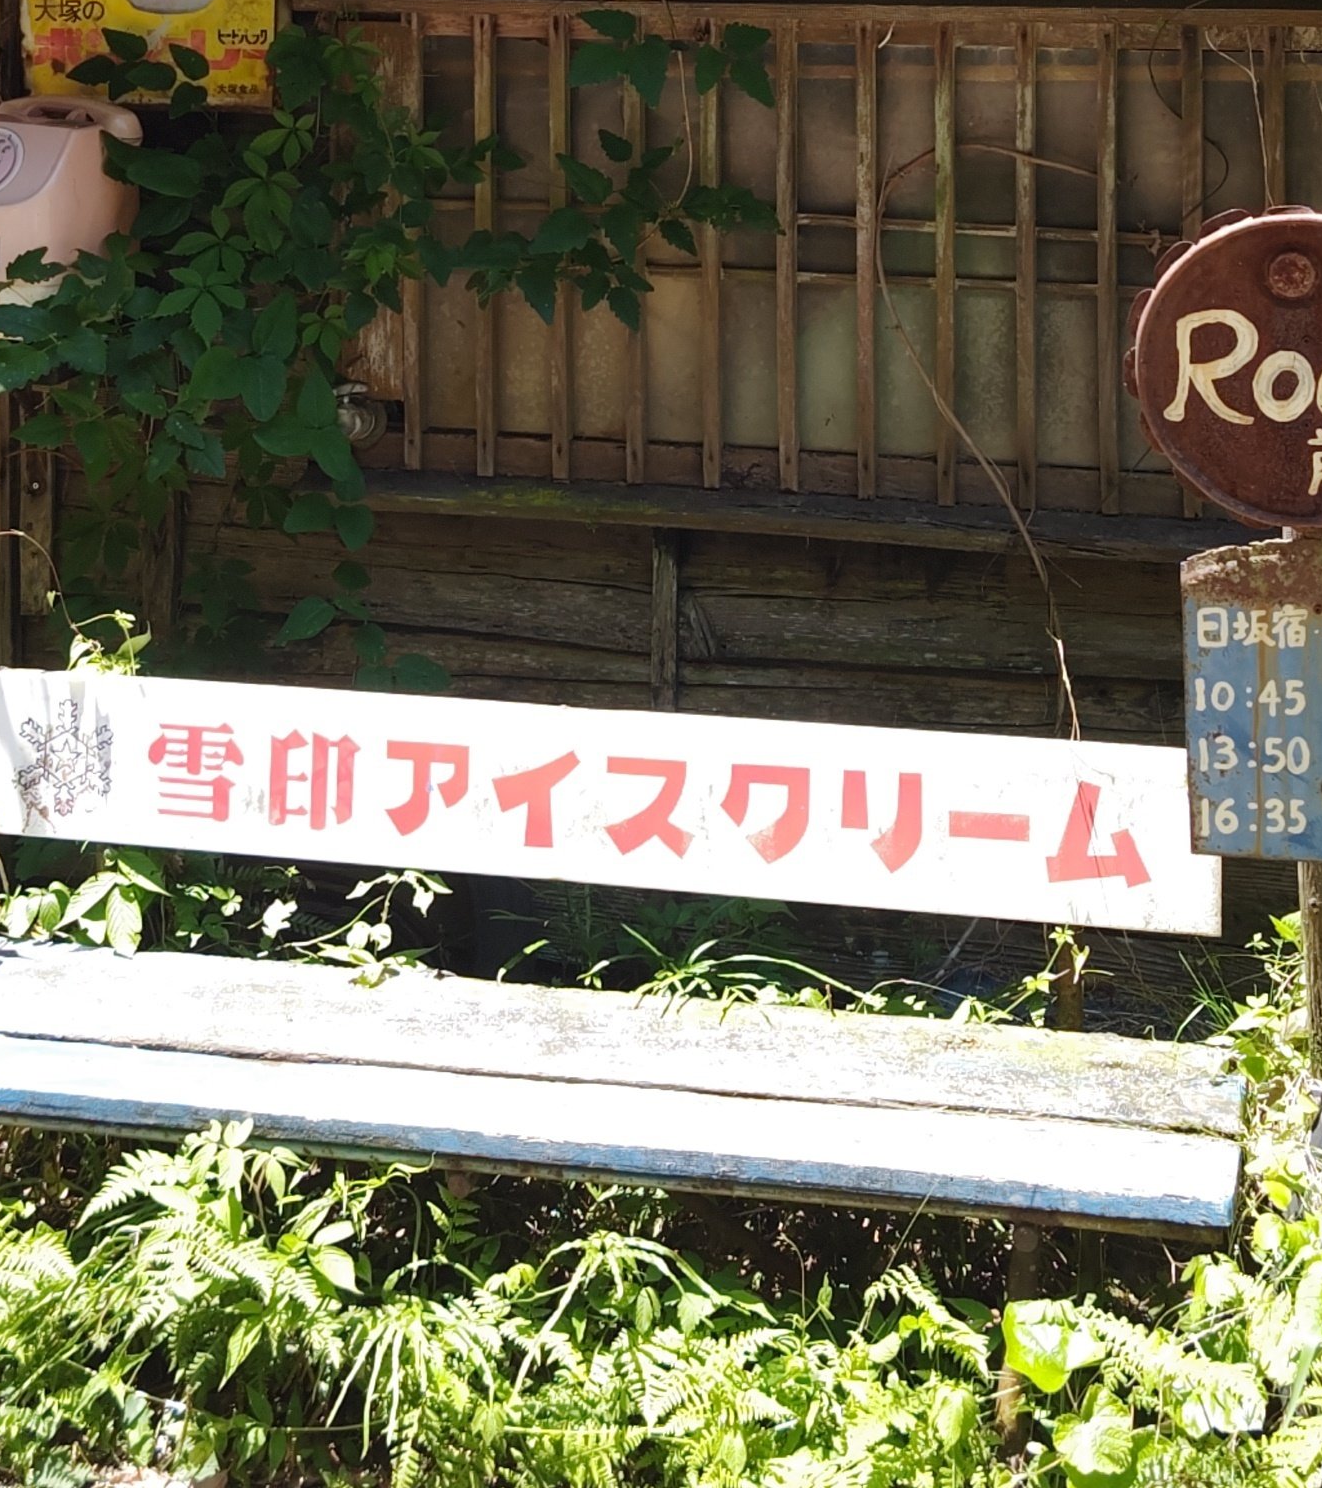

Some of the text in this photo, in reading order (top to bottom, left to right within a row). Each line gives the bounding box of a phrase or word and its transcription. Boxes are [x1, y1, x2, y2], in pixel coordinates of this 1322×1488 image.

[1194, 677, 1307, 717] 10:45
[1198, 735, 1311, 775] 13:50
[147, 722, 1152, 888] 雪印アイスクリーム
[1201, 797, 1308, 837] 16:35
